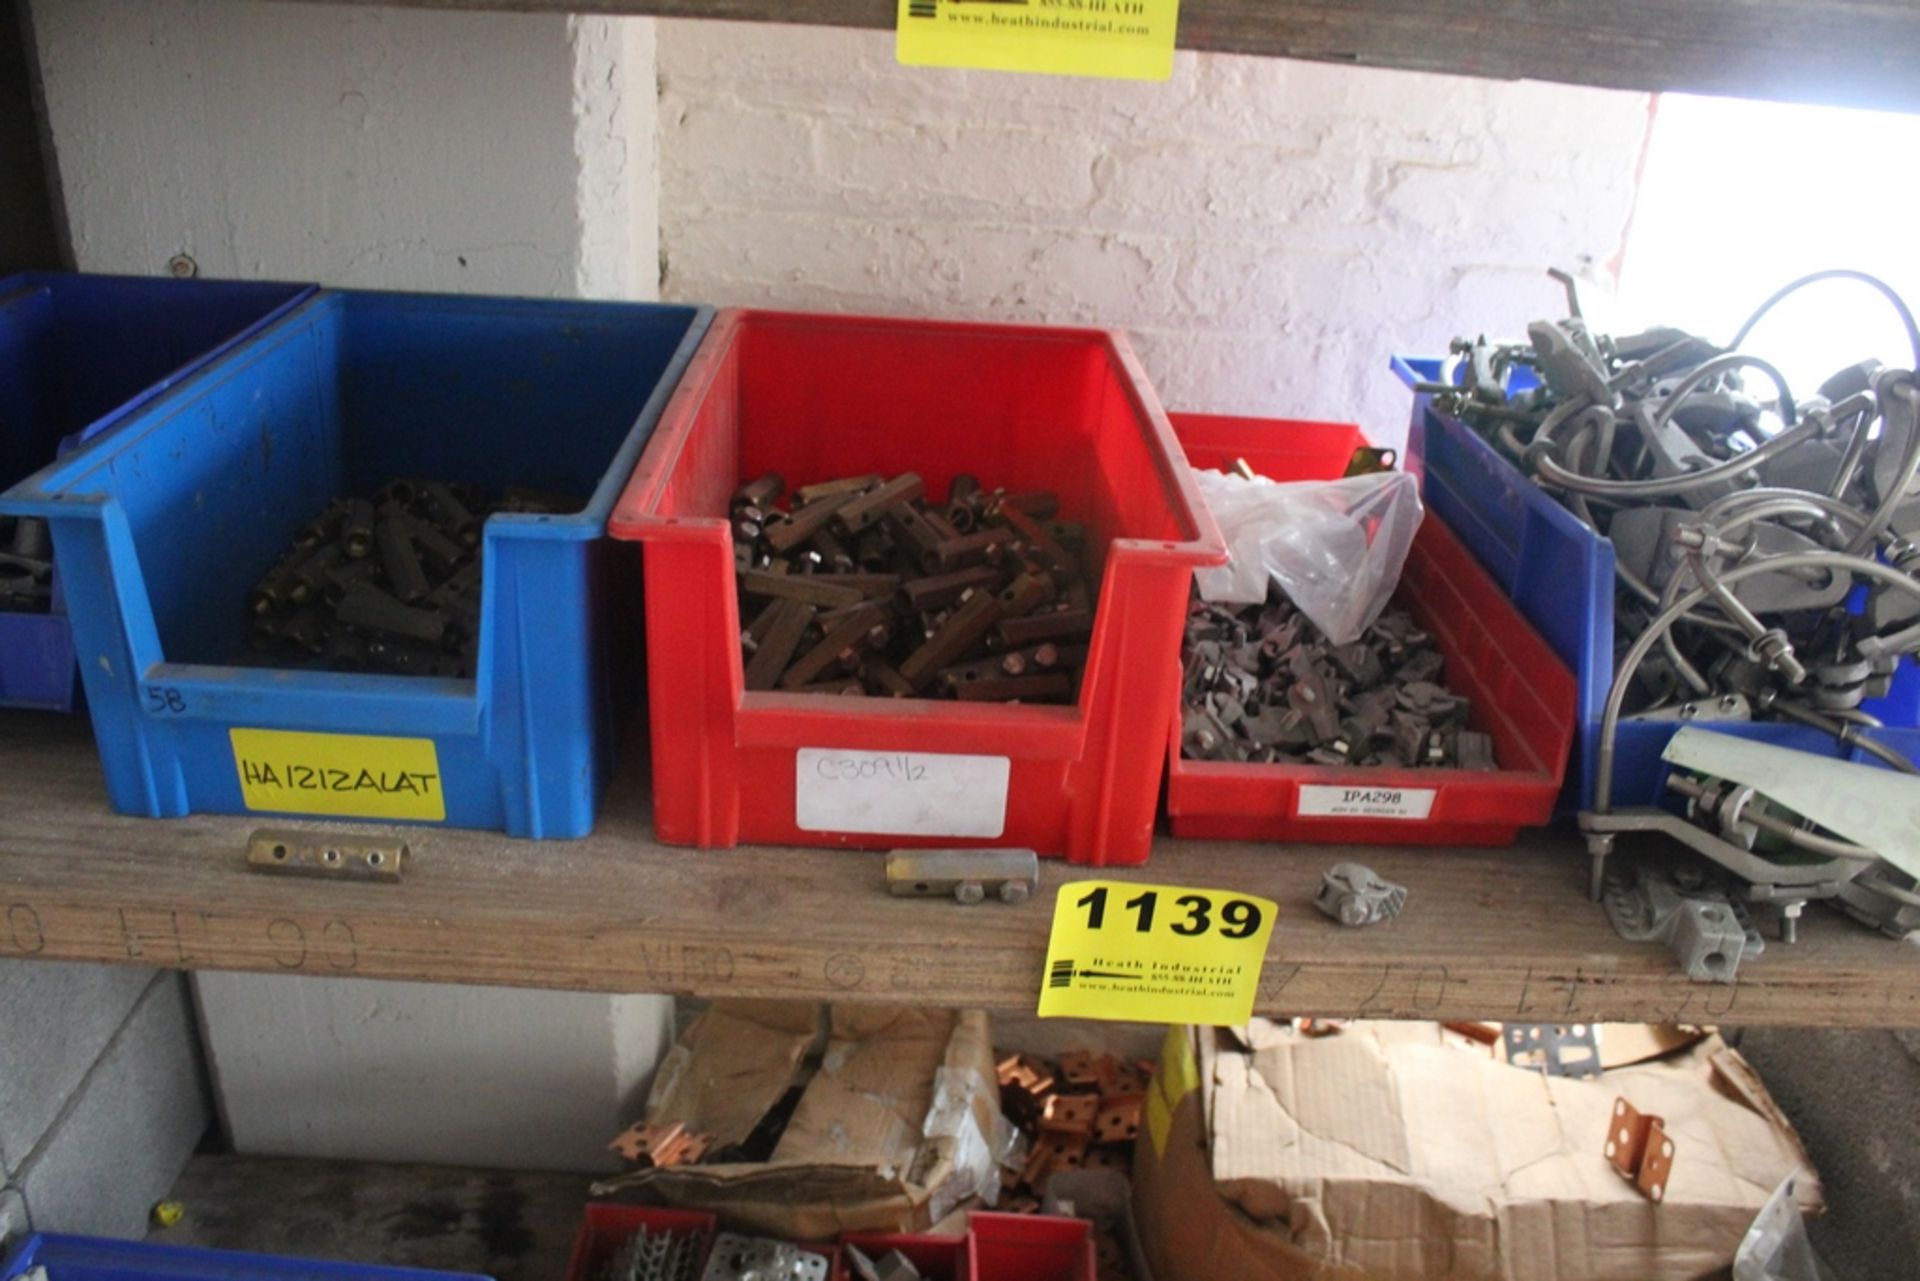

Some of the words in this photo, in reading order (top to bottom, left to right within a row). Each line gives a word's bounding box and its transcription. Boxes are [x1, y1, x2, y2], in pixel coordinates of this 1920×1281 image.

[948, 13, 1149, 35] www.heathindustrial.com
[1343, 790, 1402, 804] IPA298
[1077, 887, 1262, 939] 1139
[1092, 957, 1143, 970] Heath
[1152, 960, 1242, 975] Industrial
[1079, 981, 1236, 999] www.heathindustrial.com
